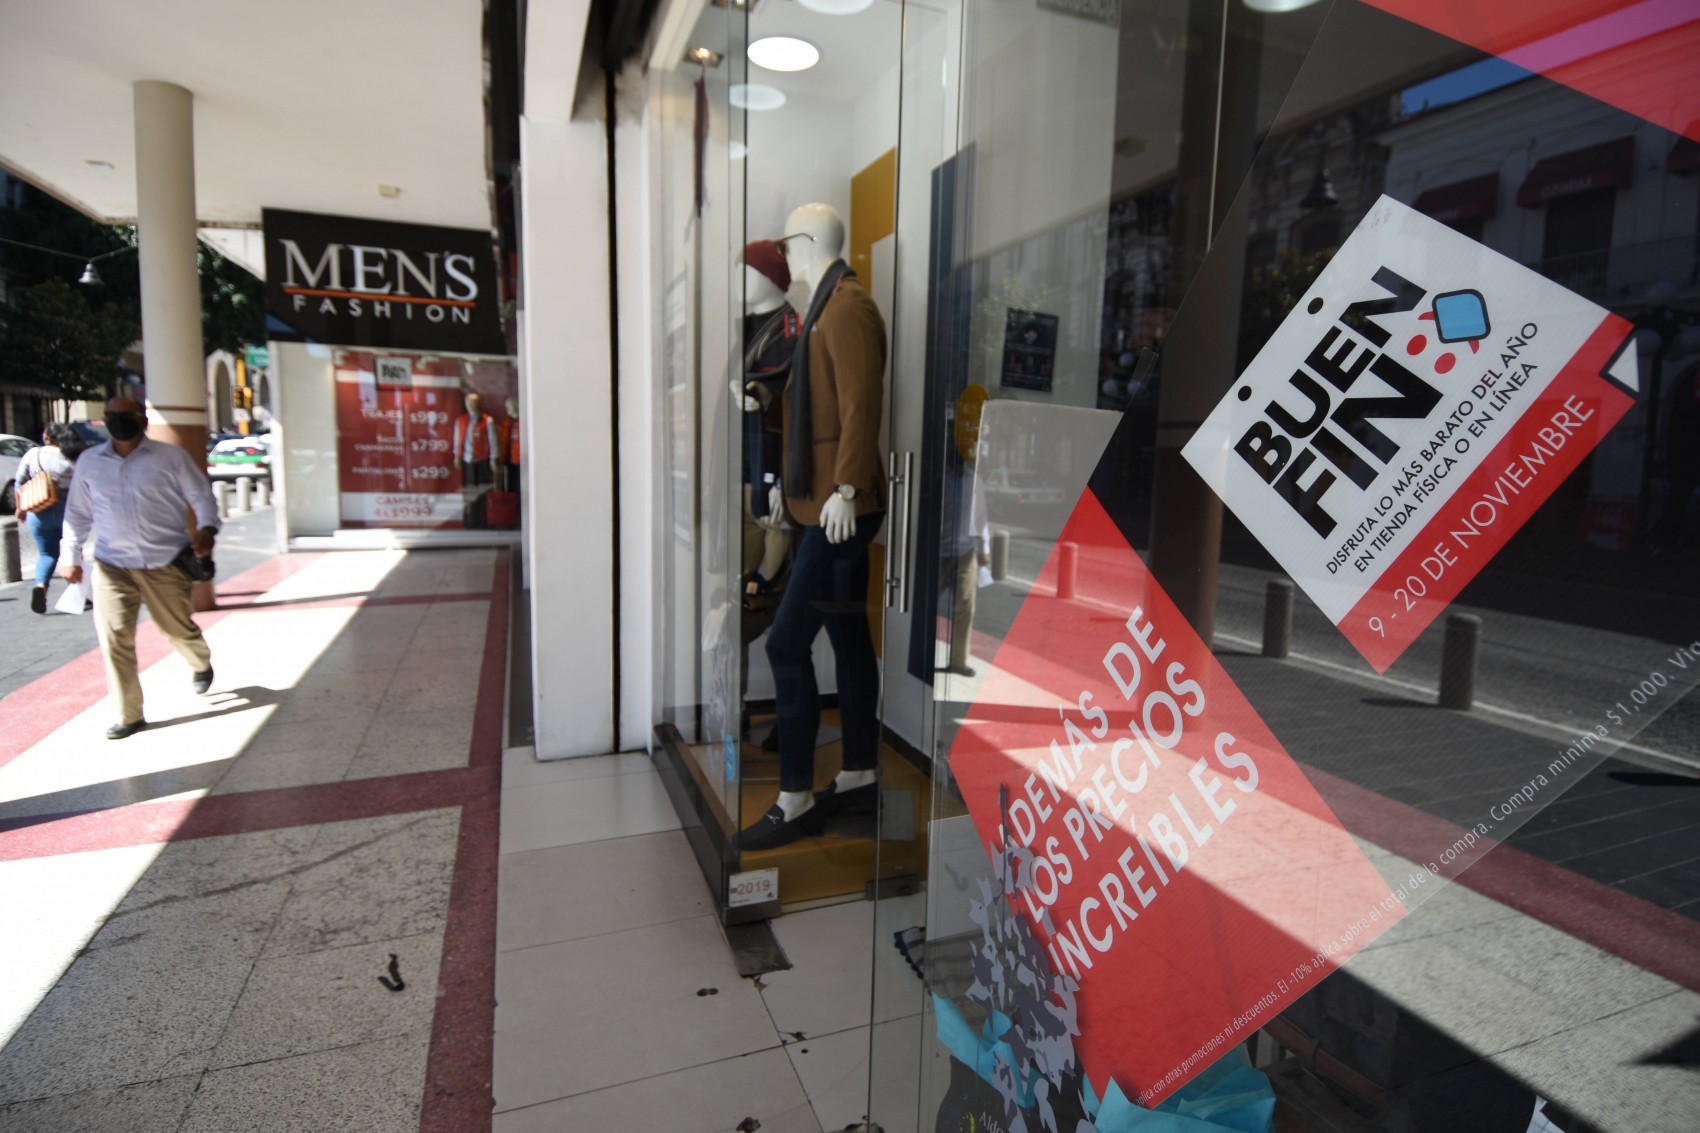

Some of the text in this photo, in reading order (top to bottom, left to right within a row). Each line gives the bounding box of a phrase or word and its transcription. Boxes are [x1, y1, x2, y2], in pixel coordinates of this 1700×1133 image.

[293, 295, 471, 325] FASHION
[1233, 265, 1428, 485] BUEN
[411, 465, 450, 480] $299
[1272, 352, 1444, 540] FIN
[1326, 322, 1538, 575] DISFRUTA LO MÁS BARATO DEL AÑO
[1353, 362, 1538, 573] EN TIENDA FÍSICA O EN LÍNEA
[1368, 616, 1385, 638] 9
[1393, 575, 1427, 612] 20
[1420, 542, 1458, 581] DE
[1449, 394, 1595, 549] NOVIEMBRE
[1103, 606, 1167, 700] DE
[1021, 661, 1206, 924] LOS PRECIOS
[1047, 731, 1260, 981] INCREÍBLES
[1153, 1079, 1166, 1093] con
[1165, 1066, 1183, 1084] otras
[1181, 1032, 1225, 1074] promociones
[1225, 1023, 1234, 1038] ni
[1233, 991, 1280, 1030] descuentos.
[1277, 979, 1290, 994] El
[1289, 962, 1312, 984] -10%
[1312, 941, 1342, 968] aplica
[1340, 916, 1370, 945] sobre
[1369, 908, 1382, 922] el
[1381, 883, 1409, 912] total
[1408, 873, 1426, 890] de
[1423, 862, 1439, 878] la
[1439, 821, 1493, 864] compra.
[1490, 773, 1549, 821] Compra
[1547, 724, 1609, 776] mínima
[1605, 671, 1675, 726] $1,000.
